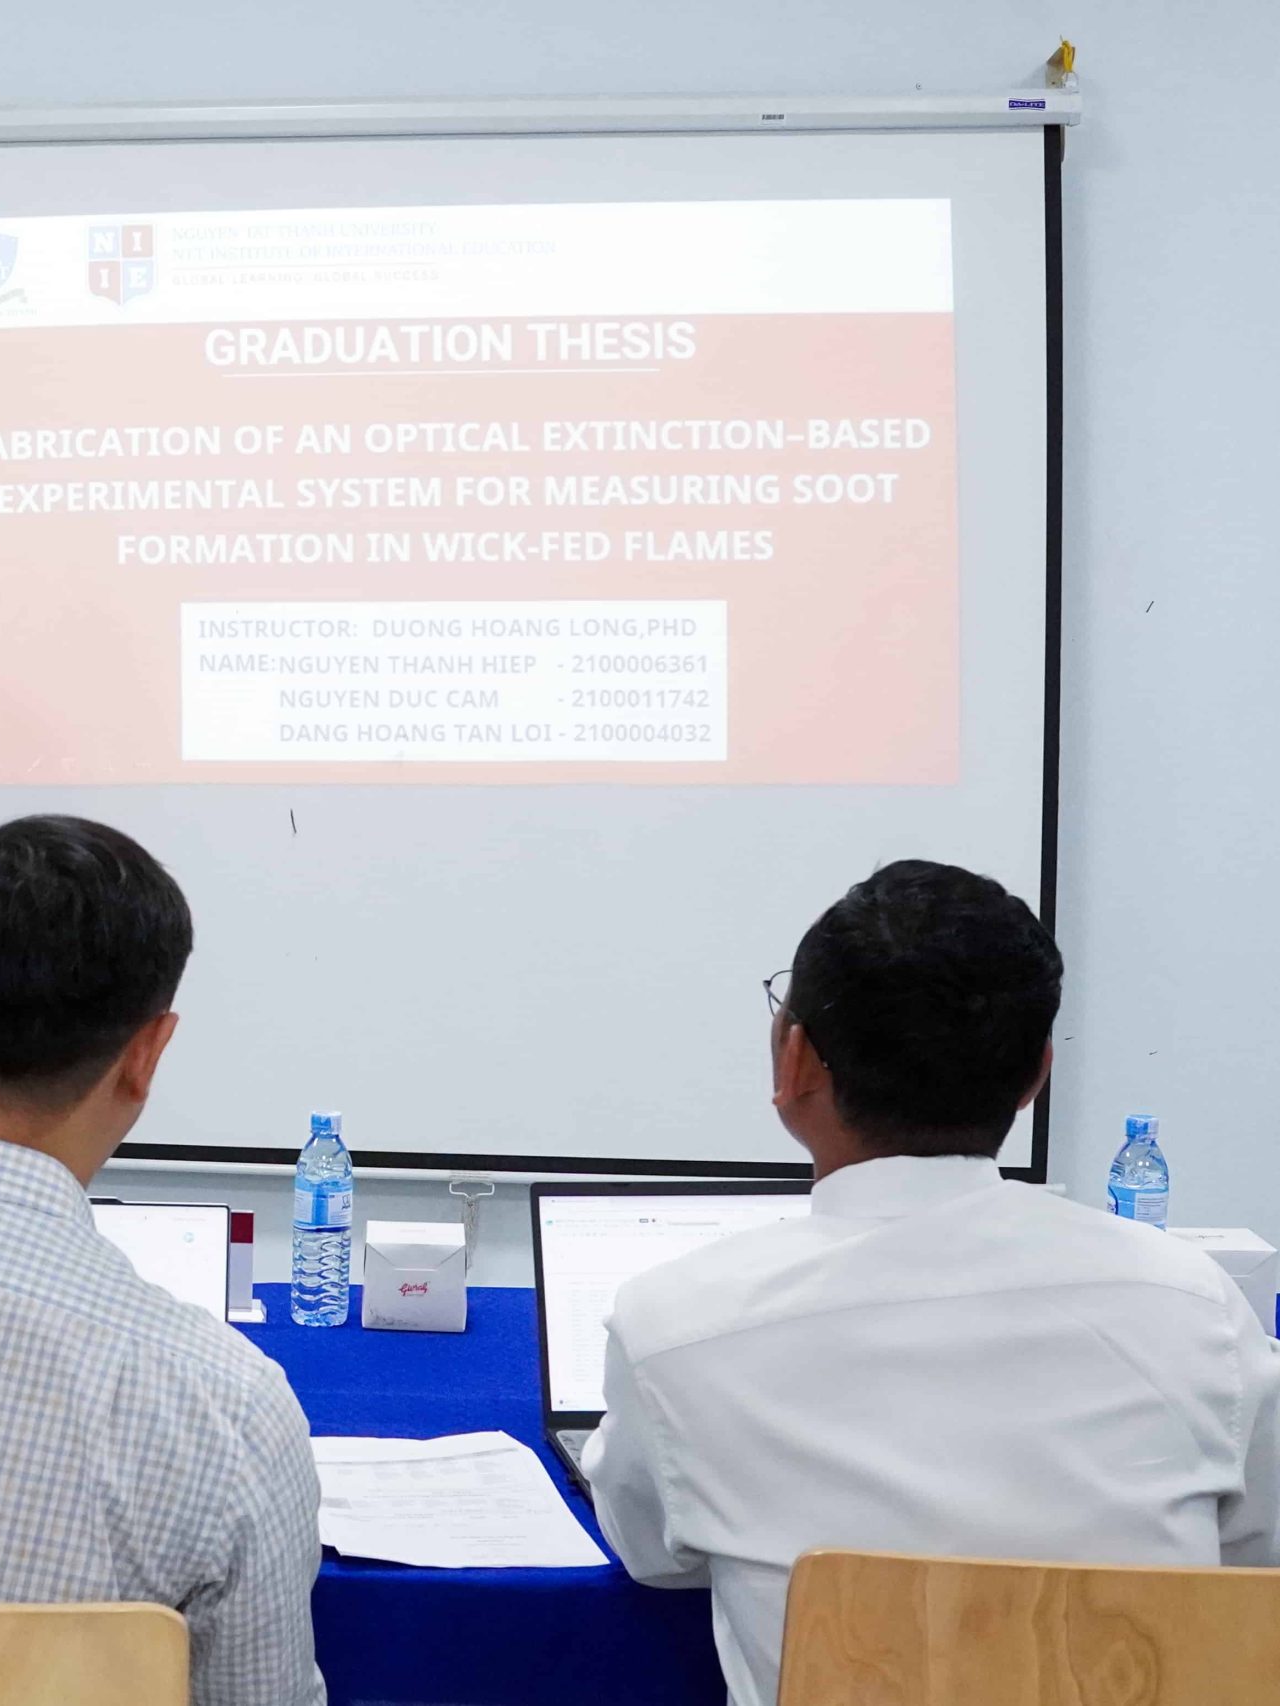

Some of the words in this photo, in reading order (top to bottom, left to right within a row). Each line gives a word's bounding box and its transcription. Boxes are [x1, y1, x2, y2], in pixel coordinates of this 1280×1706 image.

[324, 241, 458, 258] INTERNATIONAL
[460, 238, 557, 256] EDUCATION
[206, 325, 512, 366] GRADUATION
[526, 321, 696, 361] THESIS
[234, 425, 284, 455] OF
[295, 424, 351, 454] AN
[364, 422, 531, 453] OPTICAL
[296, 477, 441, 508] SYSTEM
[456, 476, 531, 506] FOR
[544, 474, 780, 506] MEASURING
[792, 473, 899, 505] SOOT
[118, 533, 354, 565] FORMATION
[366, 532, 410, 563] IN
[422, 531, 611, 562] WICK-FED
[624, 530, 774, 561] FLAMES
[199, 619, 358, 639] INSTRUCTOR:
[372, 618, 462, 638] DUONG
[471, 618, 561, 638] HOANG
[569, 618, 697, 640] LONG,PHD
[387, 655, 473, 675] THANH
[481, 654, 537, 674] HIEP
[571, 654, 707, 674] 2100006361
[279, 689, 380, 709] NGUYEN
[389, 689, 438, 709] DUC
[446, 689, 499, 709] CAM
[571, 688, 710, 709] 2100011742
[279, 723, 348, 743] DANG
[357, 723, 446, 743] HOANG
[453, 723, 502, 743] TAN
[511, 723, 552, 743] LOI
[573, 723, 712, 743] 2100004032
